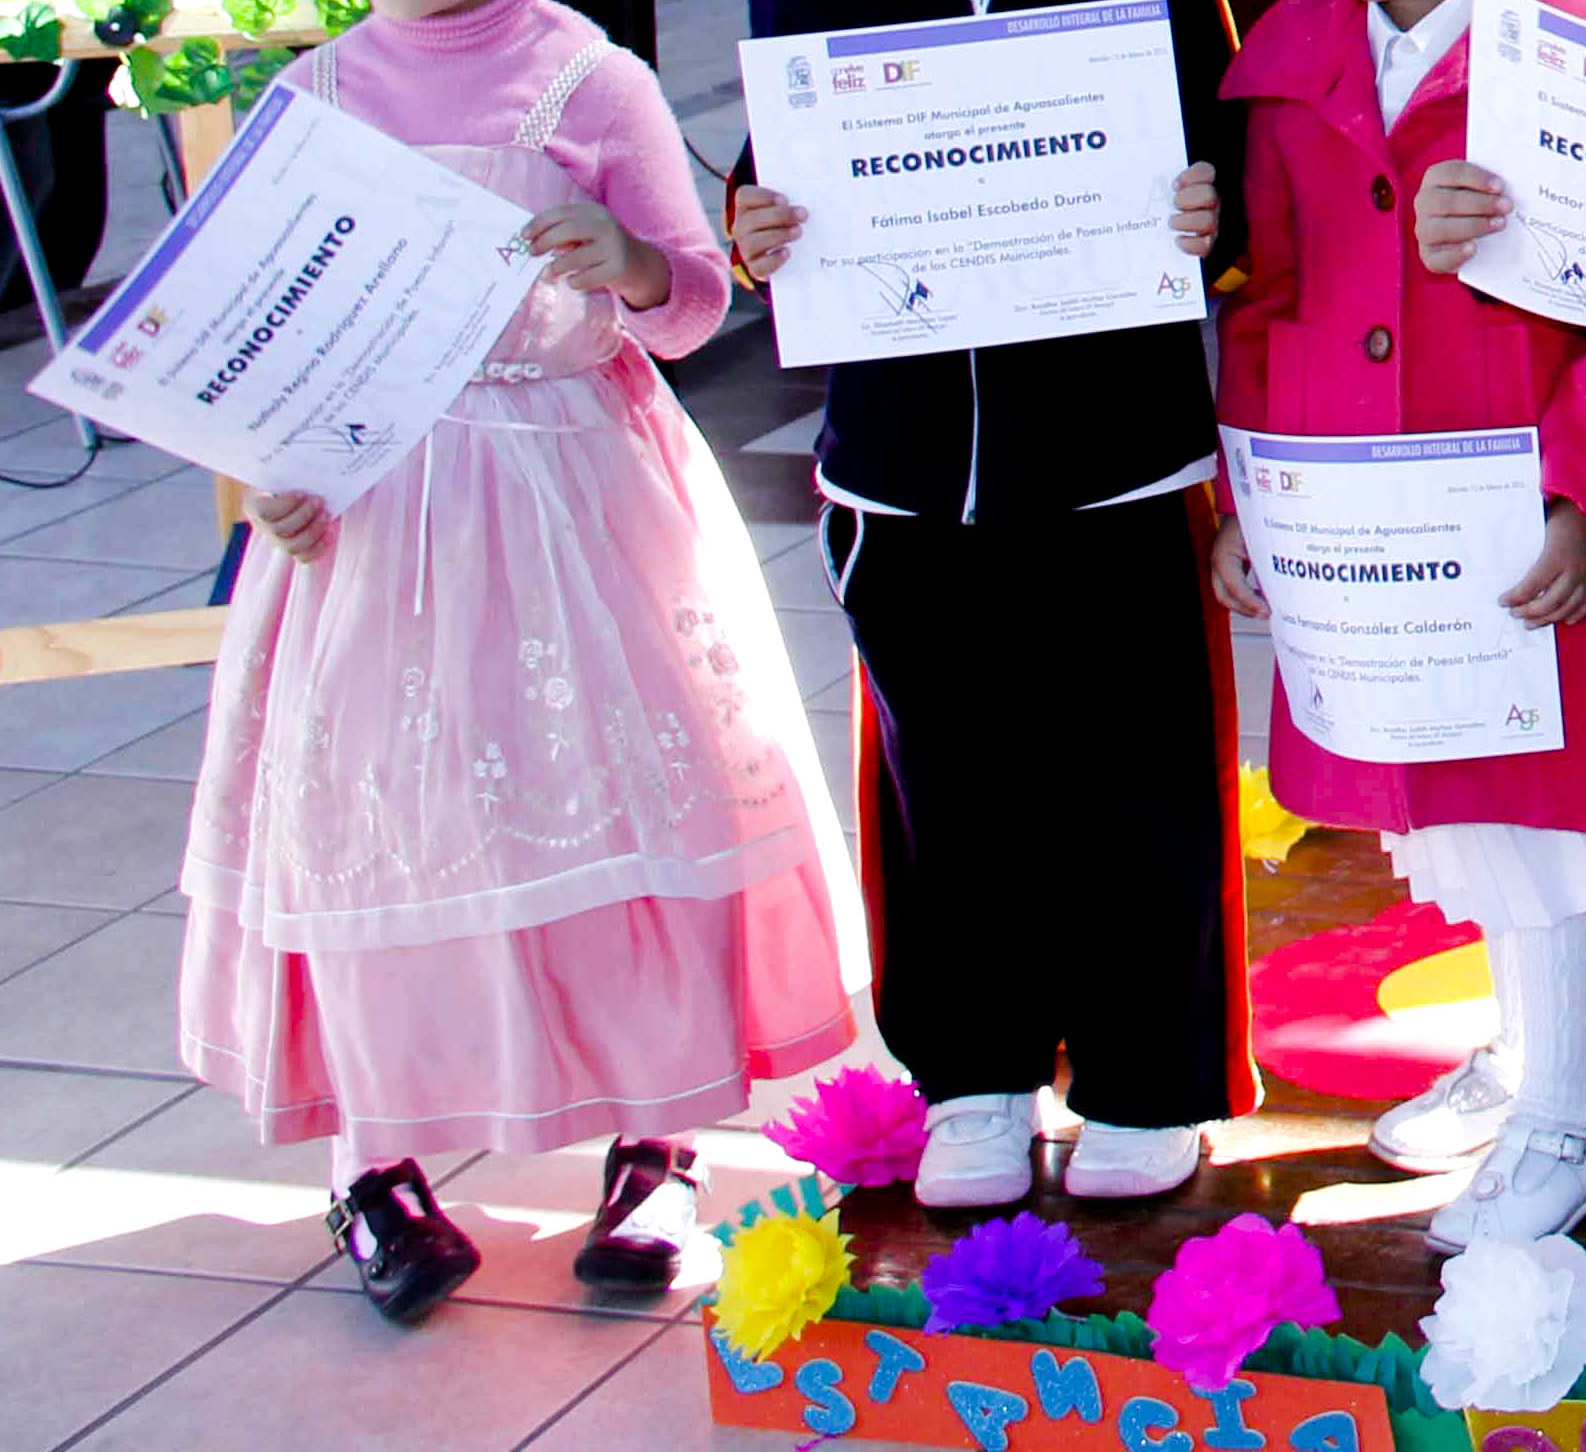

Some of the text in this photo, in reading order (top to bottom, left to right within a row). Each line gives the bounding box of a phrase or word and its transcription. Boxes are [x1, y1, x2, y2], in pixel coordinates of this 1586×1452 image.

[831, 74, 866, 93] feliz
[882, 59, 920, 85] DIF
[841, 92, 1105, 131] El Sistema DIF Municipal de Aguascalientes
[850, 130, 1107, 178] RECONOCIMIENTO
[871, 214, 923, 228] Fátima
[927, 204, 972, 223] Isabel
[976, 197, 1049, 217] Escobedo
[1156, 271, 1191, 299] Ags
[195, 216, 355, 405] RECONOCIMIENTO
[1271, 554, 1462, 583] RECONOCIMIENTO
